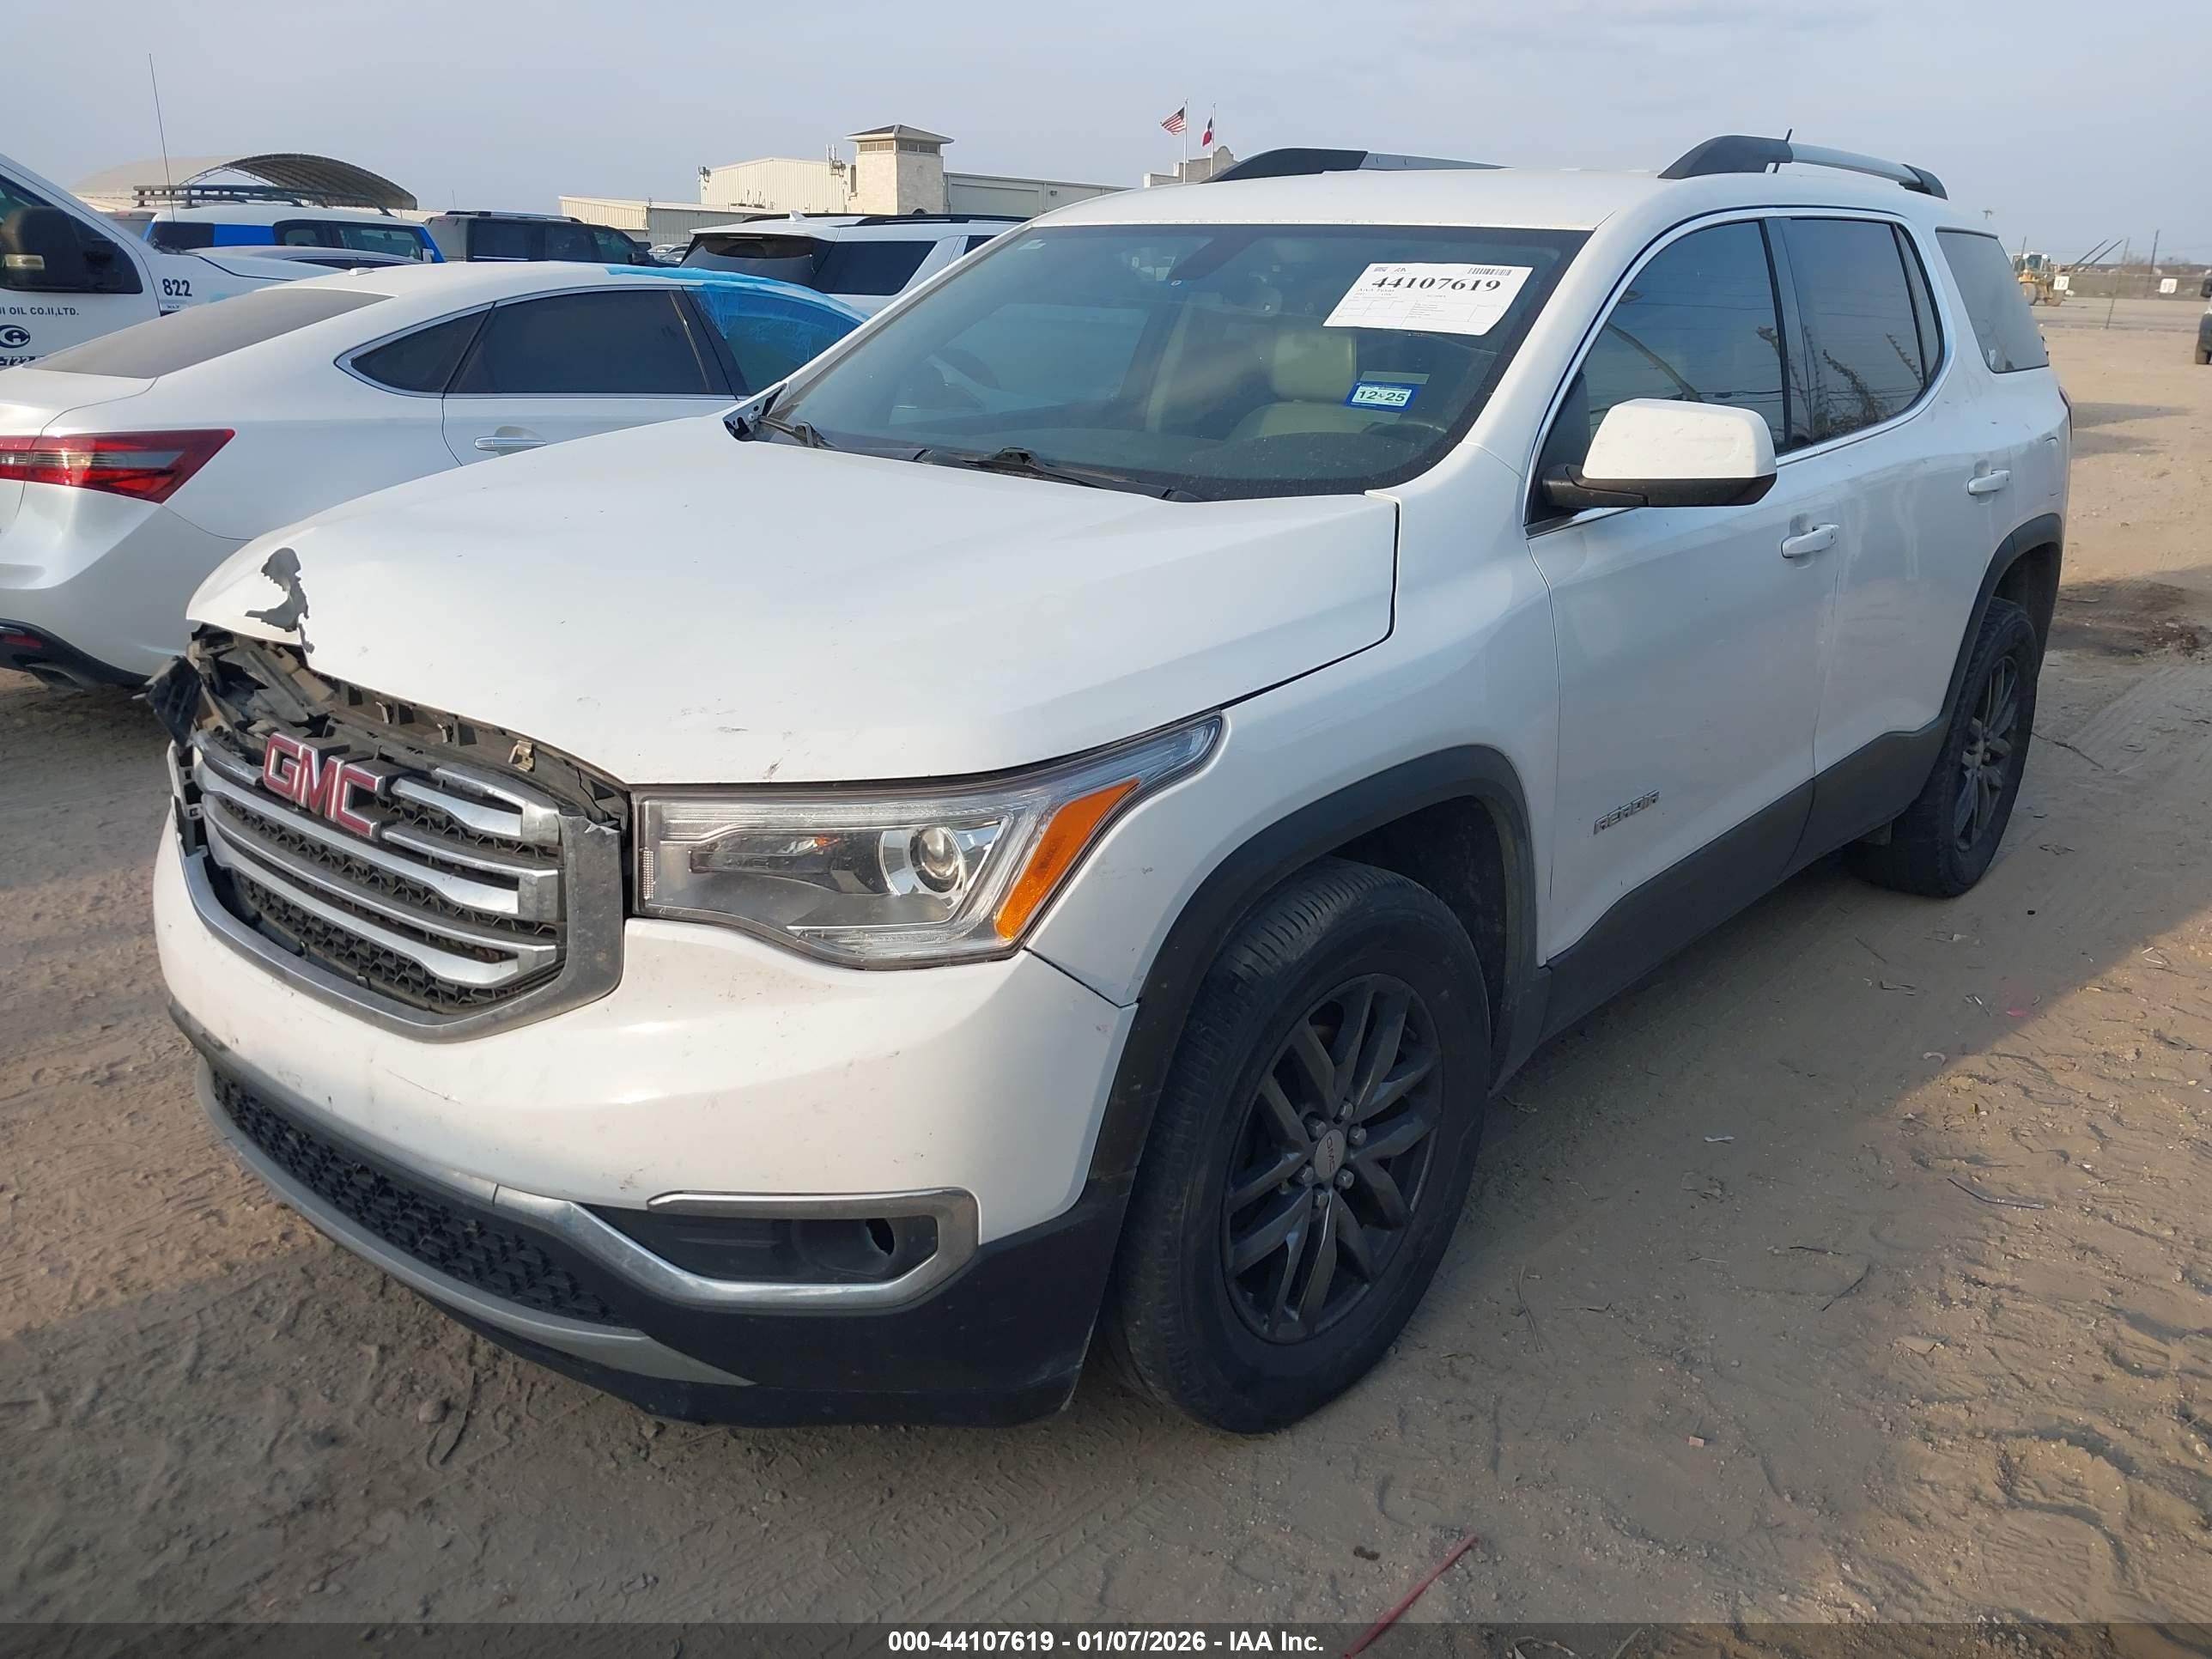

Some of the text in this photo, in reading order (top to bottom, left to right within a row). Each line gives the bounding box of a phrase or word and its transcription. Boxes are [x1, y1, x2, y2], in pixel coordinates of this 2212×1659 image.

[161, 278, 193, 297] 822
[1371, 276, 1502, 293] 44107619
[9, 307, 27, 316] OIL
[262, 732, 383, 842] GMC
[1593, 789, 1661, 836] ACADIA
